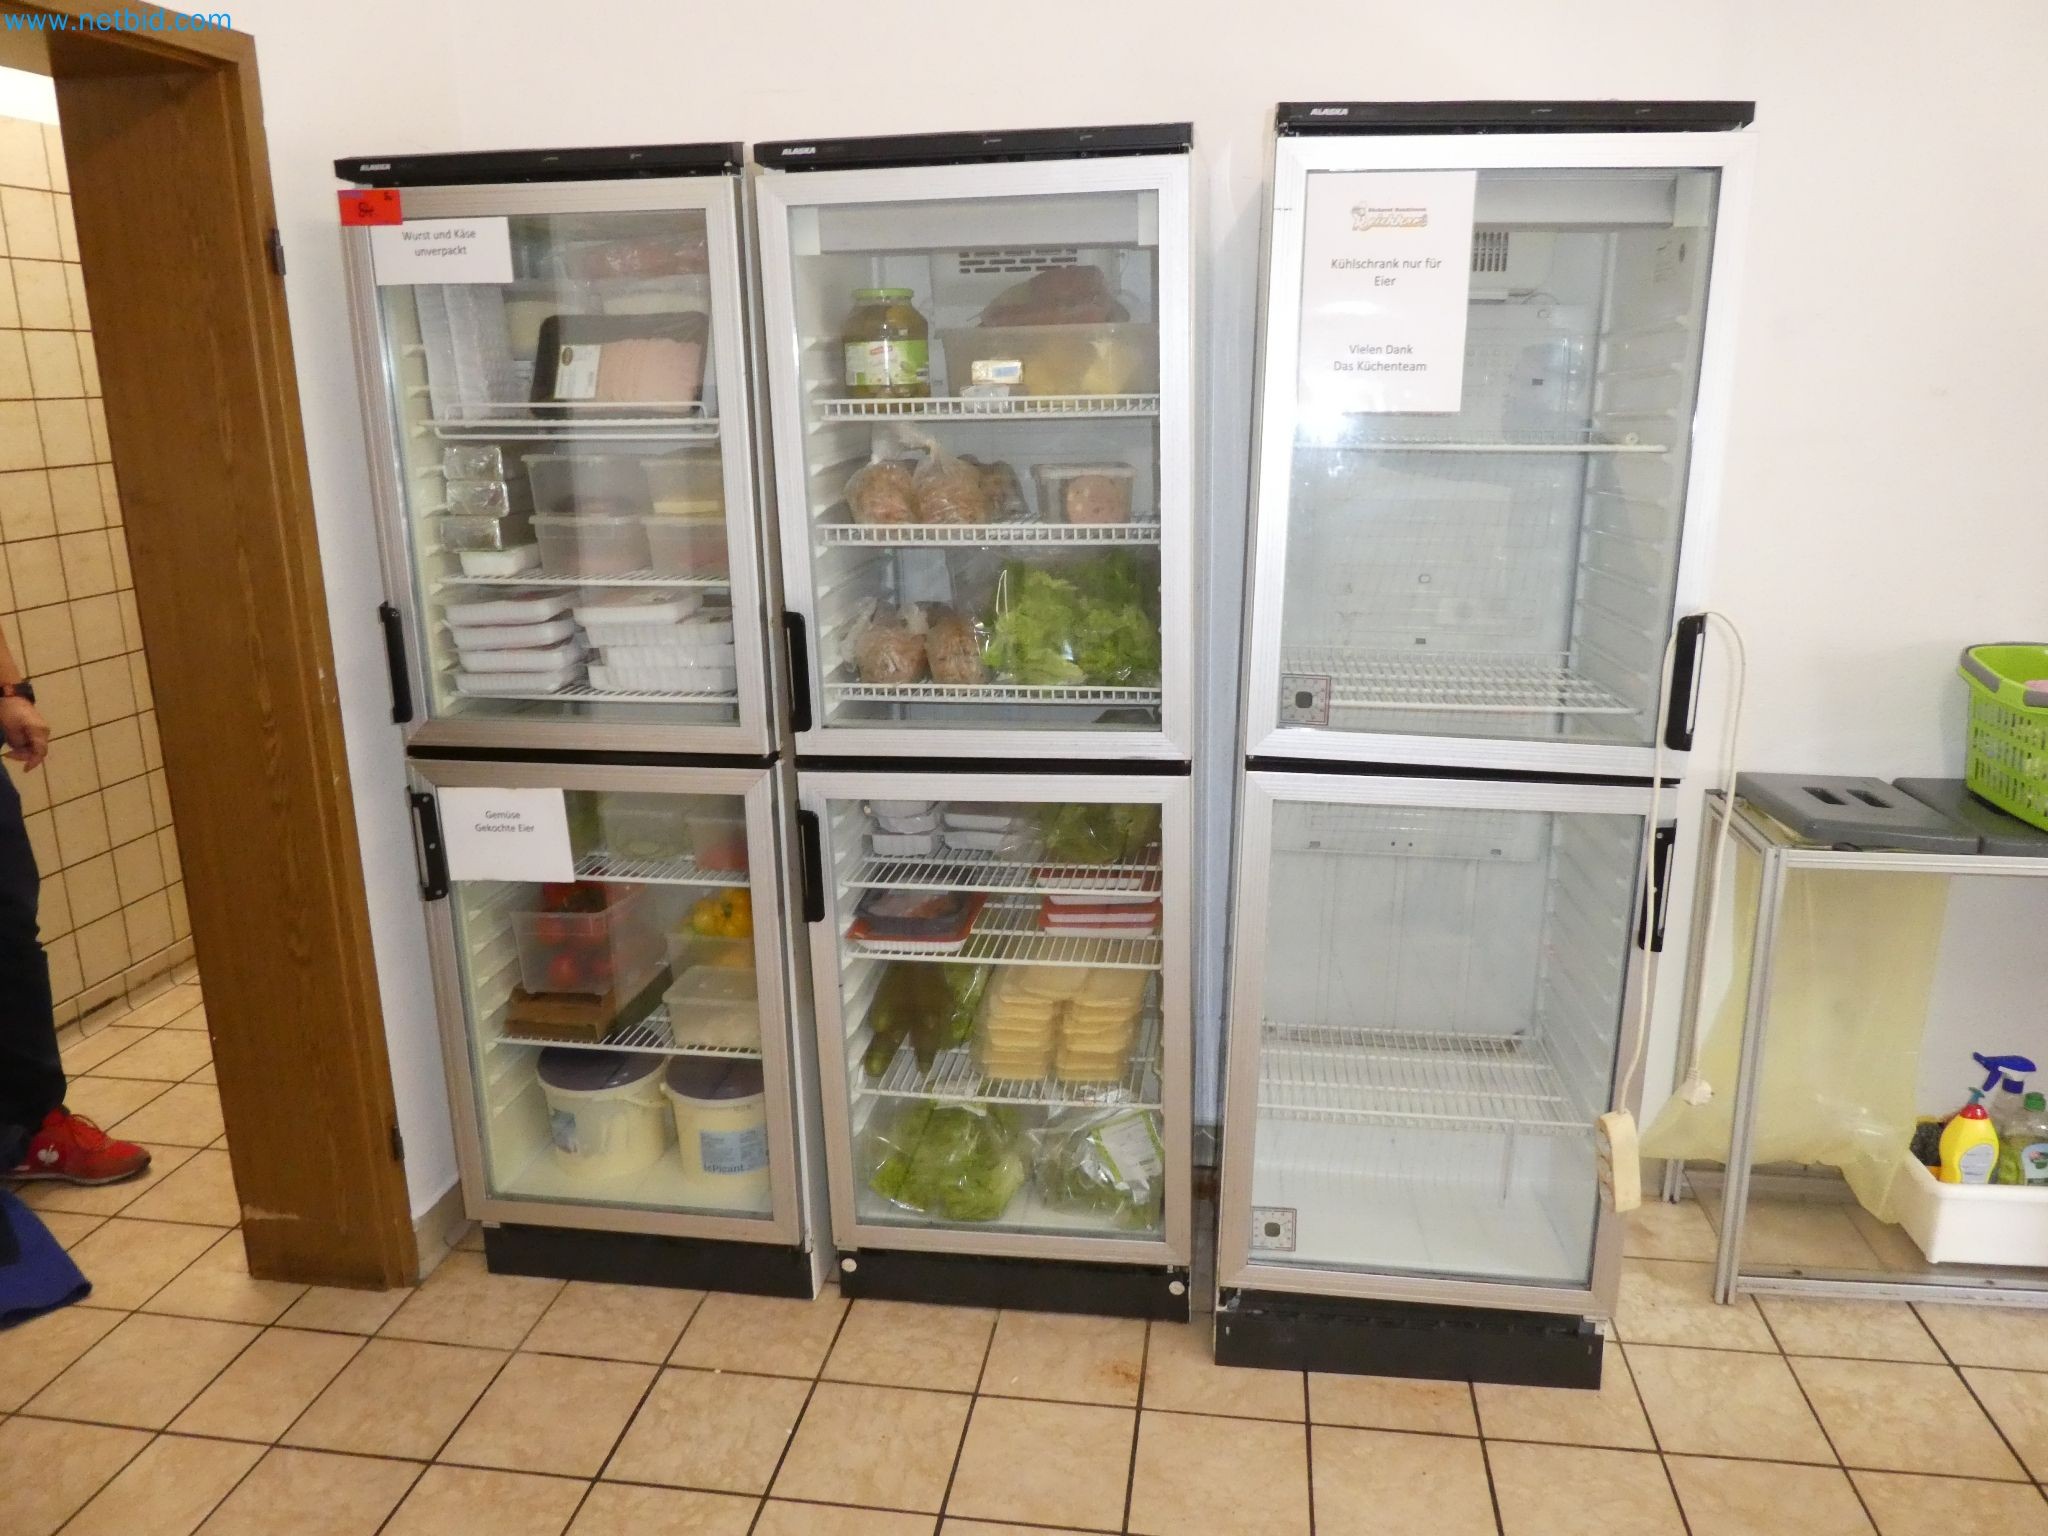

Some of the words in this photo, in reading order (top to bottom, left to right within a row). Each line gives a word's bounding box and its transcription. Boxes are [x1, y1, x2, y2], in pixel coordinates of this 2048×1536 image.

[402, 230, 431, 241] Wurst
[433, 230, 451, 240] und
[454, 229, 477, 239] Käse
[414, 246, 467, 257] unverpackt
[1330, 257, 1400, 269] Kühlschrank
[1402, 259, 1422, 269] nur
[1425, 257, 1442, 269] für
[1373, 275, 1396, 287] Eier
[1348, 344, 1382, 355] Vielen
[1385, 344, 1413, 355] Dank
[1333, 360, 1354, 372] Das
[1356, 360, 1427, 372] Küchenteam
[485, 810, 521, 819] Gemüse
[474, 823, 516, 833] Gekochte
[518, 823, 534, 833] Eier
